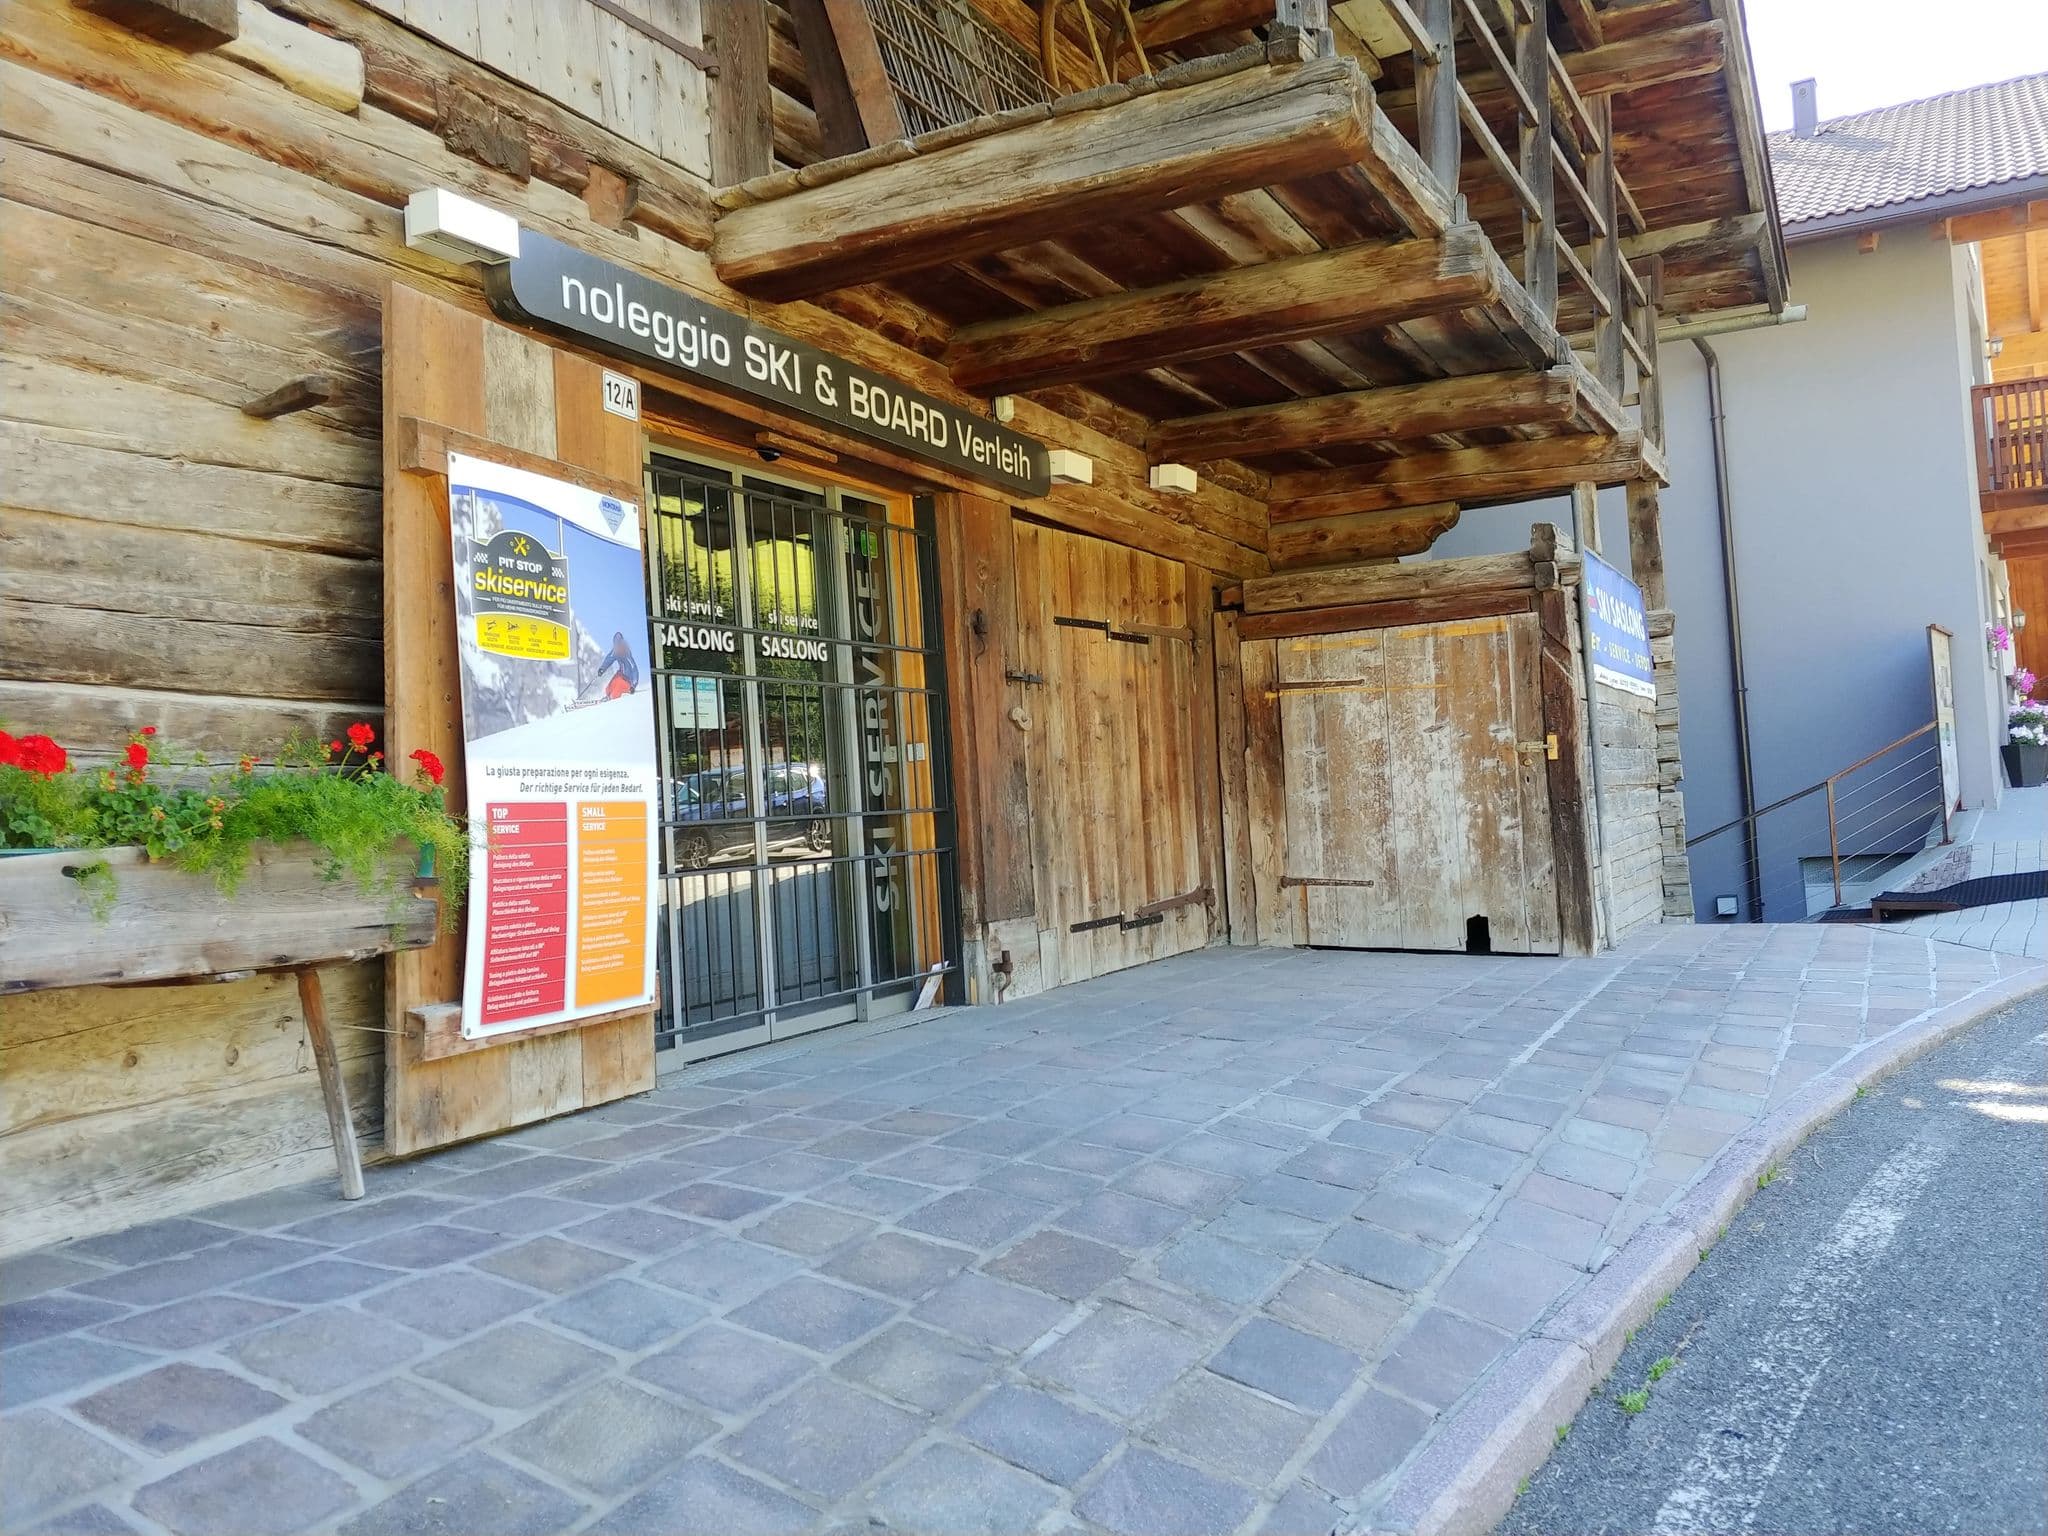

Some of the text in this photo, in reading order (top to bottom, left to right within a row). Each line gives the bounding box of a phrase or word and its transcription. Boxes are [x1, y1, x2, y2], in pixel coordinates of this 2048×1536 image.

[562, 275, 1032, 481] noleggio SKI & BOARD Verleih
[606, 380, 635, 410] 12/A
[498, 556, 543, 574] PIT STOP
[474, 566, 568, 604] skiservice
[1596, 587, 1646, 642] SKI SASLONG
[659, 623, 735, 653] SASLONG
[761, 636, 828, 662] SASLONG
[485, 765, 496, 777] La
[497, 765, 520, 779] giusta
[522, 767, 569, 780] preparazione
[571, 769, 583, 780] per
[584, 768, 599, 780] ogni
[520, 782, 534, 793] Der
[535, 782, 563, 796] richtige
[563, 782, 589, 793] Service
[590, 782, 602, 793] für
[601, 783, 620, 796] jeden
[491, 807, 509, 820] TOP
[582, 807, 606, 818] SMALL
[492, 824, 520, 835] SERVICE
[582, 821, 606, 832] SERVICE
[872, 826, 900, 914] SKI
